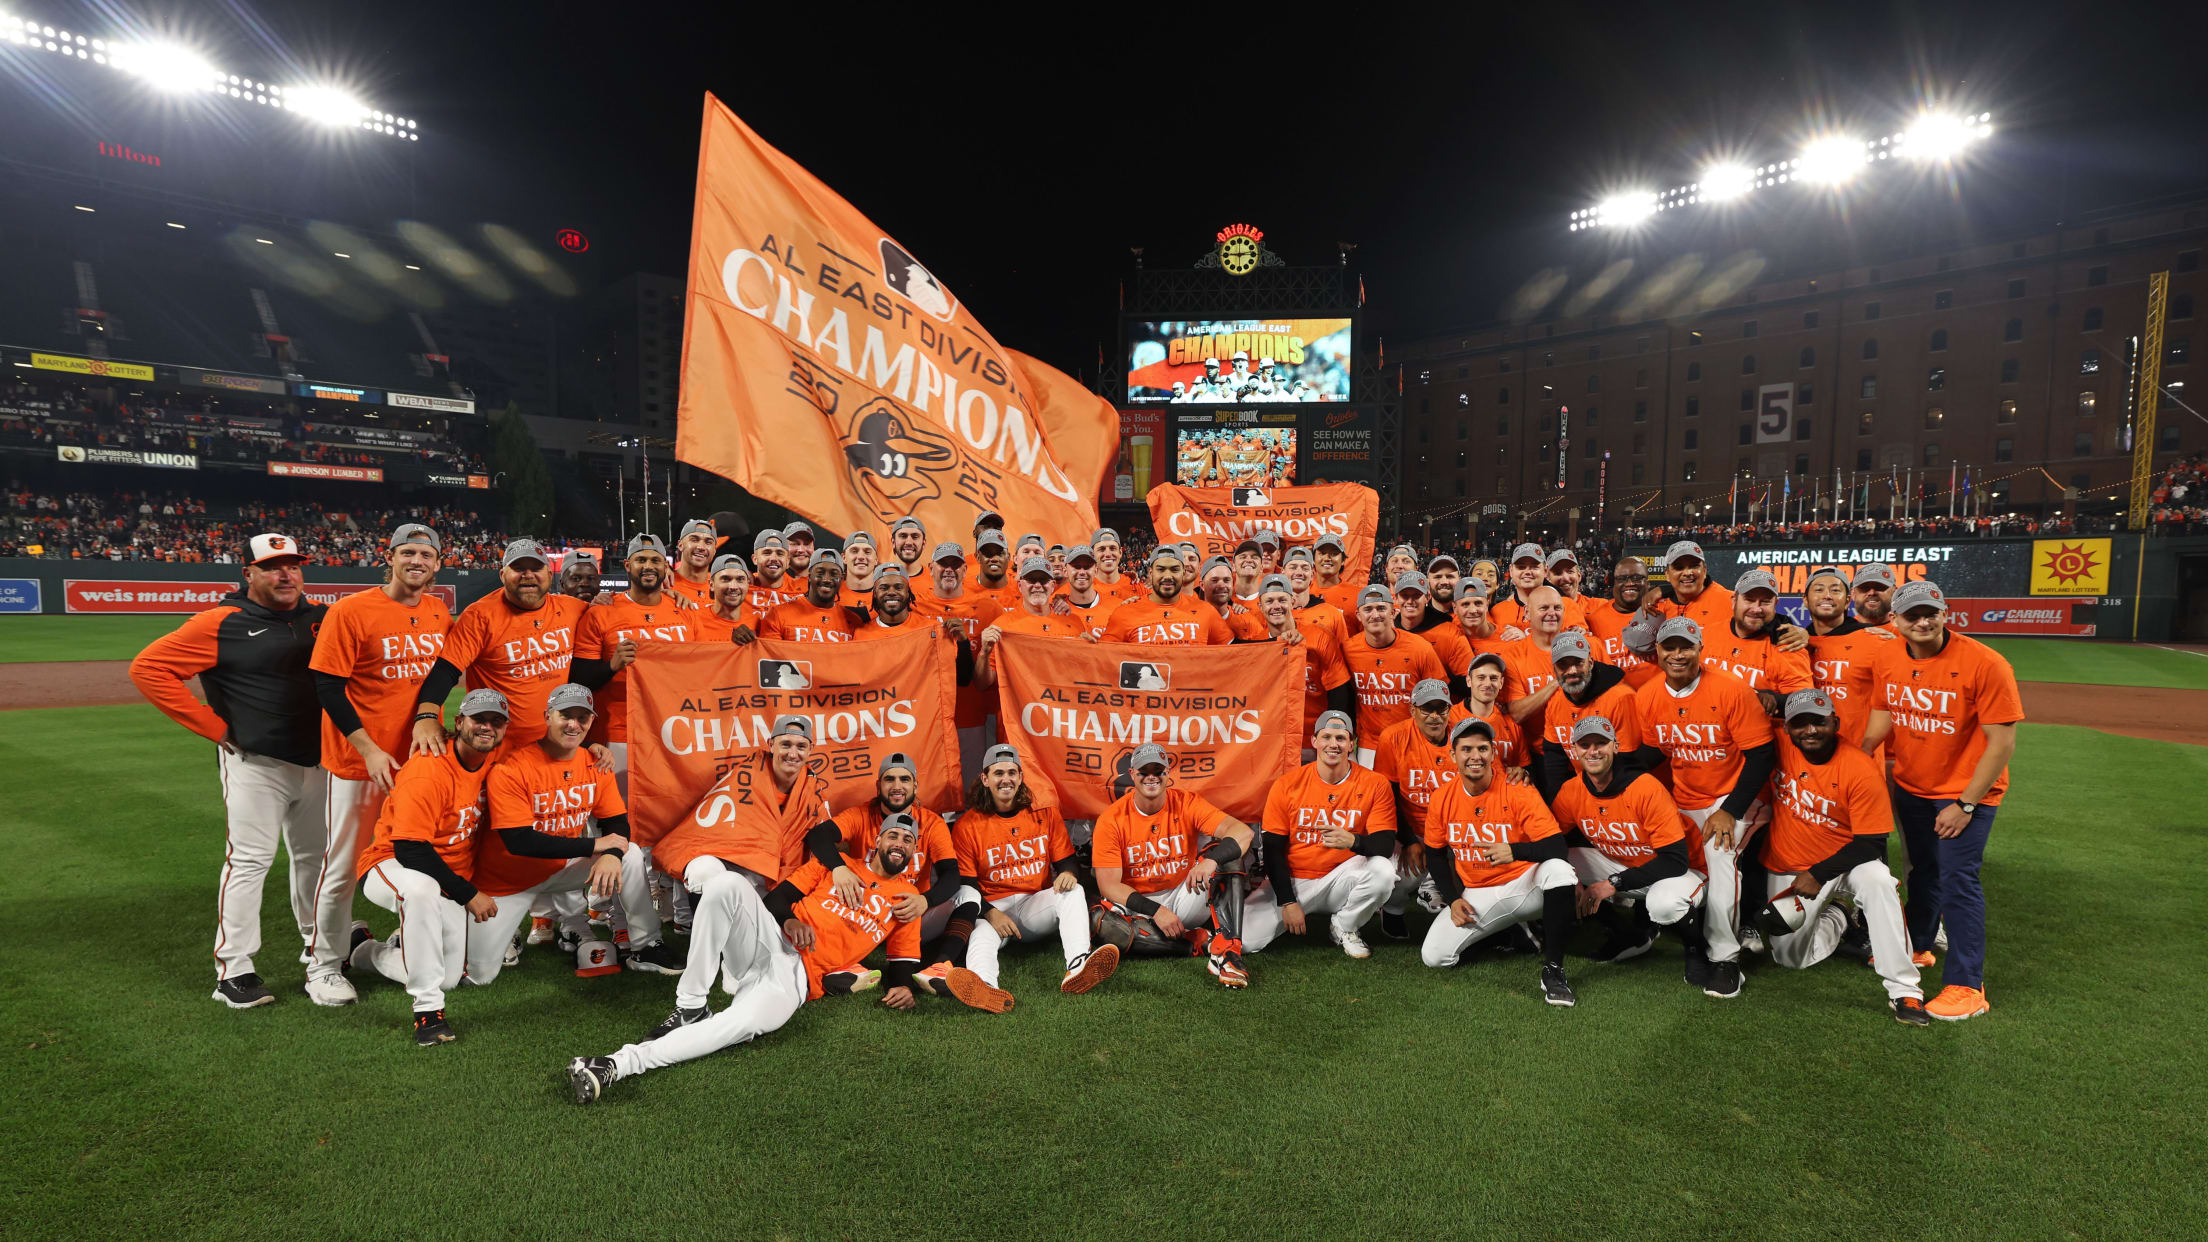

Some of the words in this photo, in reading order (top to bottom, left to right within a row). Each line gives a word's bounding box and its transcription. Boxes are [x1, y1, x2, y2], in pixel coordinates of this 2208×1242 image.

[1216, 223, 1264, 243] ORIOLES
[759, 233, 805, 276] AL
[817, 263, 913, 331] EAST
[920, 319, 1020, 402] DIVIS
[1187, 323, 1231, 335] AMERICAN
[1233, 323, 1267, 333] LEAGUE
[1268, 323, 1291, 333] EAST
[1168, 333, 1305, 367] CHAMPIONS
[37, 357, 88, 370] MARYLAND
[108, 367, 148, 377] LOTTERY
[315, 390, 360, 402] CHAMPIONS
[396, 395, 433, 408] WBAL
[1119, 413, 1132, 423] his
[1134, 413, 1160, 423] Bud's
[1215, 410, 1259, 423] SUPERBOOK
[1760, 390, 1790, 436] 5
[1119, 425, 1131, 433] or
[1133, 425, 1154, 433] You.
[1313, 430, 1331, 439] SEE
[1333, 430, 1355, 439] HOW
[1355, 430, 1372, 439] WE
[87, 448, 133, 458] PLUMBERS
[1313, 441, 1333, 450] CAN
[1335, 441, 1361, 450] MAKE
[1361, 441, 1370, 450] A
[88, 454, 109, 462] PIPE
[109, 456, 142, 464] FITTERS
[143, 452, 196, 467] UNION
[1313, 451, 1370, 461] DIFFERENCE
[291, 465, 330, 476] JOHNSON
[332, 468, 364, 478] LUMBER
[1203, 507, 1251, 518] EAST
[1255, 503, 1335, 517] DIVISION
[1168, 511, 1350, 542] CHAMPIONS
[1207, 542, 1235, 554] 20
[1737, 550, 1822, 564] AMERICAN
[1828, 548, 1897, 563] LEAGUE
[1902, 547, 1954, 562] EAST
[80, 588, 134, 602] weis
[752, 590, 805, 607] EA
[2102, 598, 2122, 606] 318
[2006, 609, 2063, 619] CARROLL
[616, 625, 688, 643] EAST
[1137, 622, 1200, 644] EAST
[381, 632, 445, 660] EAST
[504, 628, 571, 663] EAST
[381, 660, 437, 679] CHAM
[399, 655, 436, 665] DIVISIO
[1353, 671, 1411, 690] EAST
[1813, 660, 1850, 681] ST
[680, 697, 712, 713] AL
[718, 693, 783, 711] EAST
[789, 686, 898, 709] DIVISION
[1040, 687, 1071, 703] AL
[1078, 691, 1140, 709] EAST
[1146, 694, 1248, 711] DIVISION
[1887, 683, 1957, 714] EAST
[1021, 701, 1262, 746] CHAMPIONS
[1891, 711, 1956, 735] CHAMPS
[1655, 723, 1721, 745] EAST
[832, 752, 872, 774] 23
[1065, 751, 1103, 770] 20
[1179, 756, 1216, 774] 23
[1672, 747, 1727, 762] HAMPS
[1408, 768, 1463, 789] EAS
[532, 783, 597, 815] EAST
[1774, 769, 1837, 816] EAST
[1297, 808, 1362, 829] EAST
[1295, 831, 1328, 844] CHA
[1448, 822, 1513, 844] EAST
[1580, 818, 1640, 842] EAST
[986, 834, 1049, 869] EAST
[1127, 834, 1185, 864] EAST
[1452, 848, 1487, 862] CHA
[1129, 857, 1189, 879] CHAMPS
[827, 885, 894, 924] ST
[820, 898, 885, 944] CHAMPS
